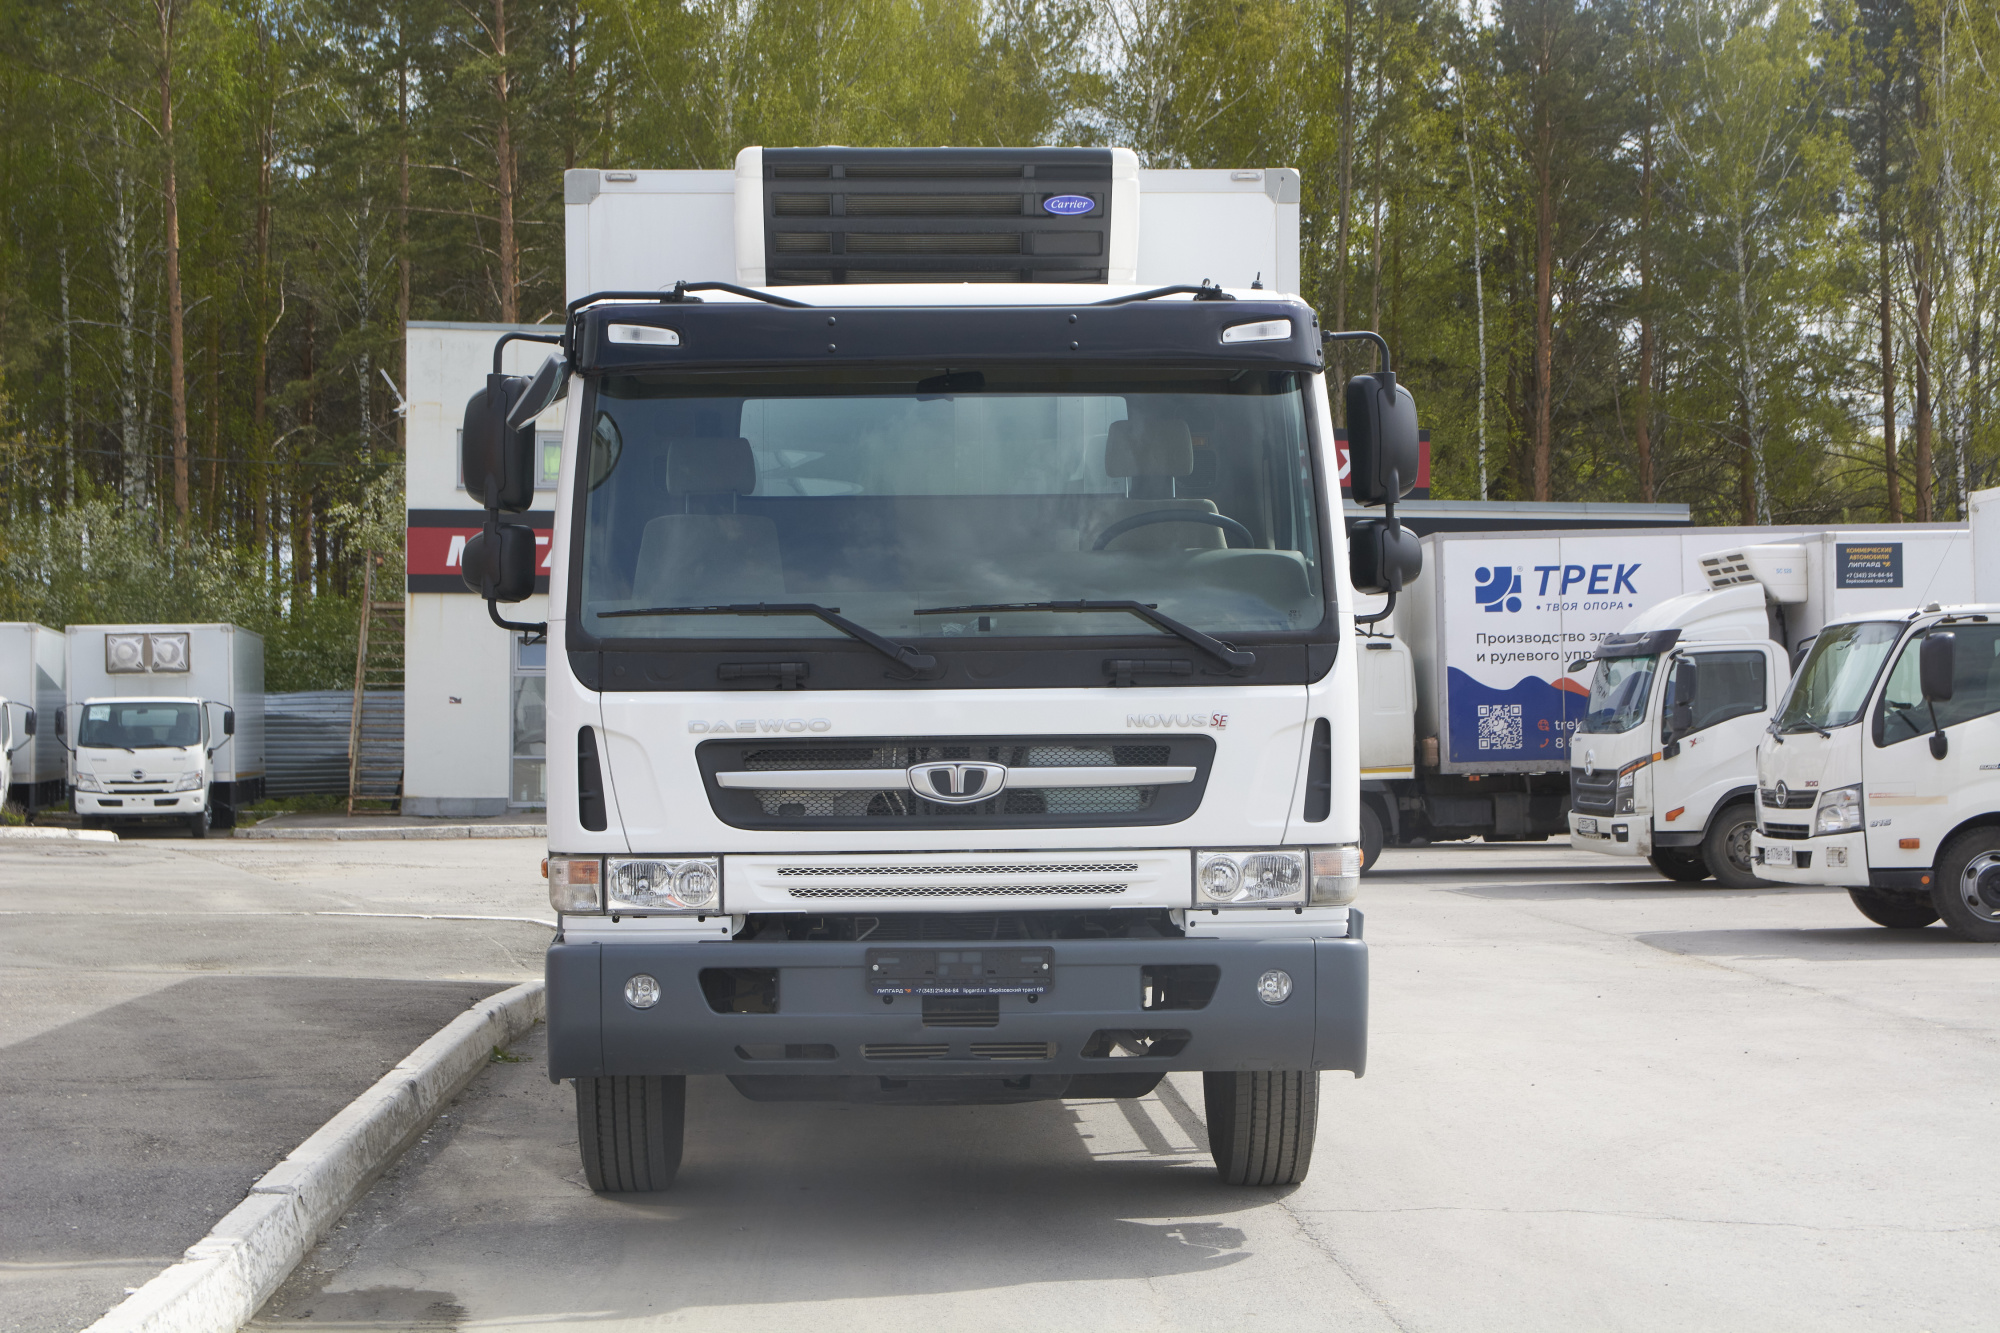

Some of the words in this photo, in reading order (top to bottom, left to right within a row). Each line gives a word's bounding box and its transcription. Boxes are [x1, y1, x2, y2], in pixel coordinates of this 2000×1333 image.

[1051, 199, 1088, 209] Carrier
[1534, 564, 1642, 596] ТРЕК
[1546, 603, 1578, 611] ТВОЯ
[1583, 602, 1624, 610] ОПОРА
[1476, 633, 1585, 646] Производство
[1477, 654, 1485, 662] и
[1490, 652, 1559, 664] рулевого
[688, 718, 831, 733] DAEWOO
[1126, 713, 1208, 728] NOVUS
[1210, 713, 1228, 728] SE
